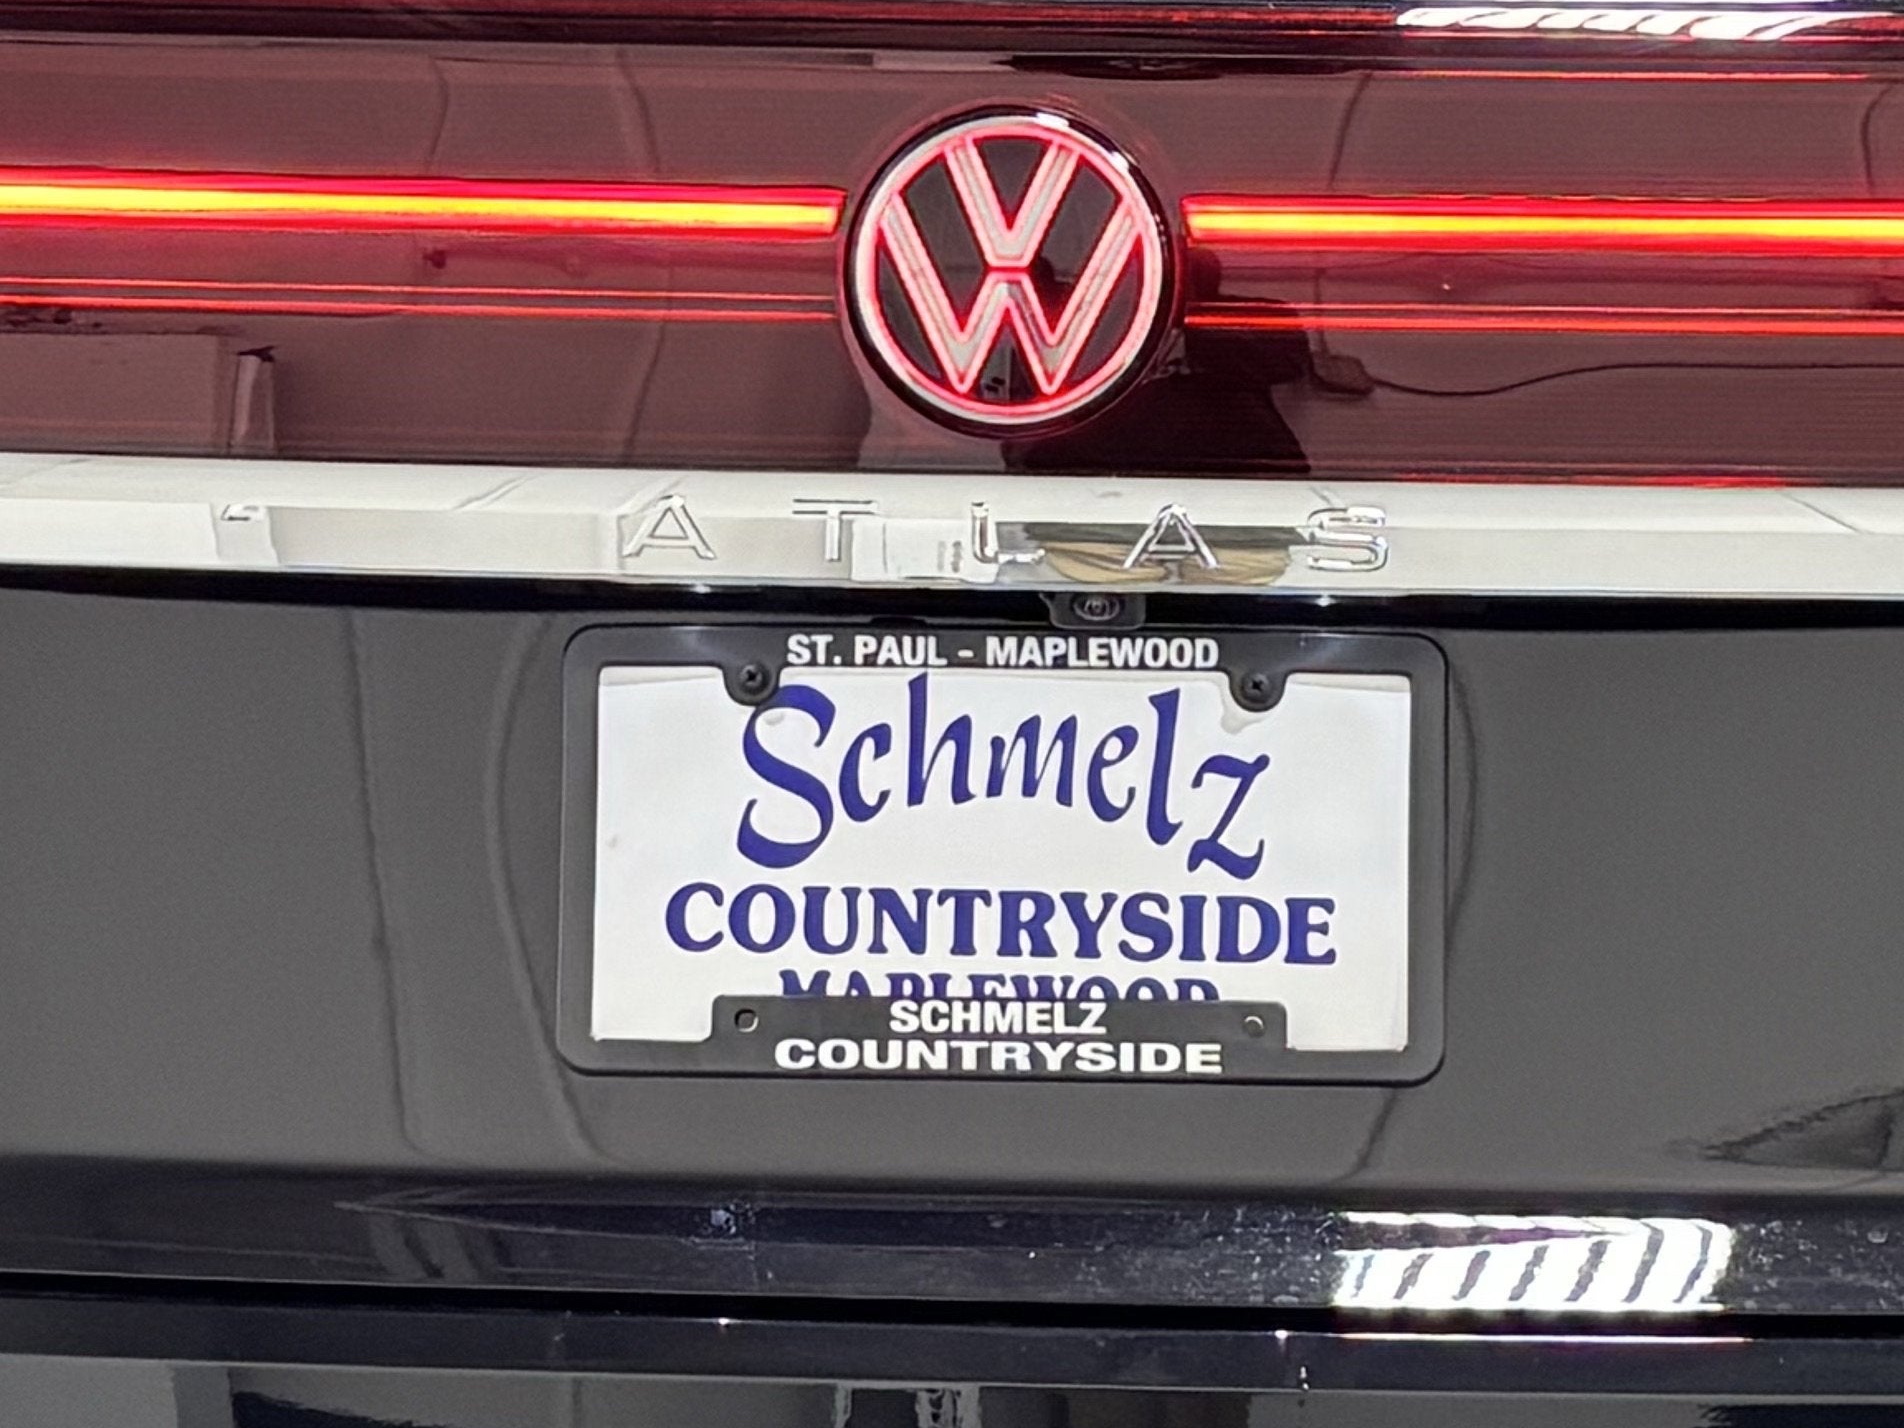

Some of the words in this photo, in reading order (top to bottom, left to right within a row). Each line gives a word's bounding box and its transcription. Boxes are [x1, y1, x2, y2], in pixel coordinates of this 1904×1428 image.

[876, 134, 1146, 395] VW
[621, 493, 1389, 574] ATLAS
[786, 634, 842, 666] ST.
[853, 634, 948, 667] PAUL
[985, 635, 1220, 669] MAPLEWOOD
[737, 672, 1271, 880] Schmelz
[664, 881, 1338, 965] COUNTRYSIDE
[774, 1038, 1224, 1074] COUNTRYSIDE
[889, 999, 1108, 1035] SCHMELZ
